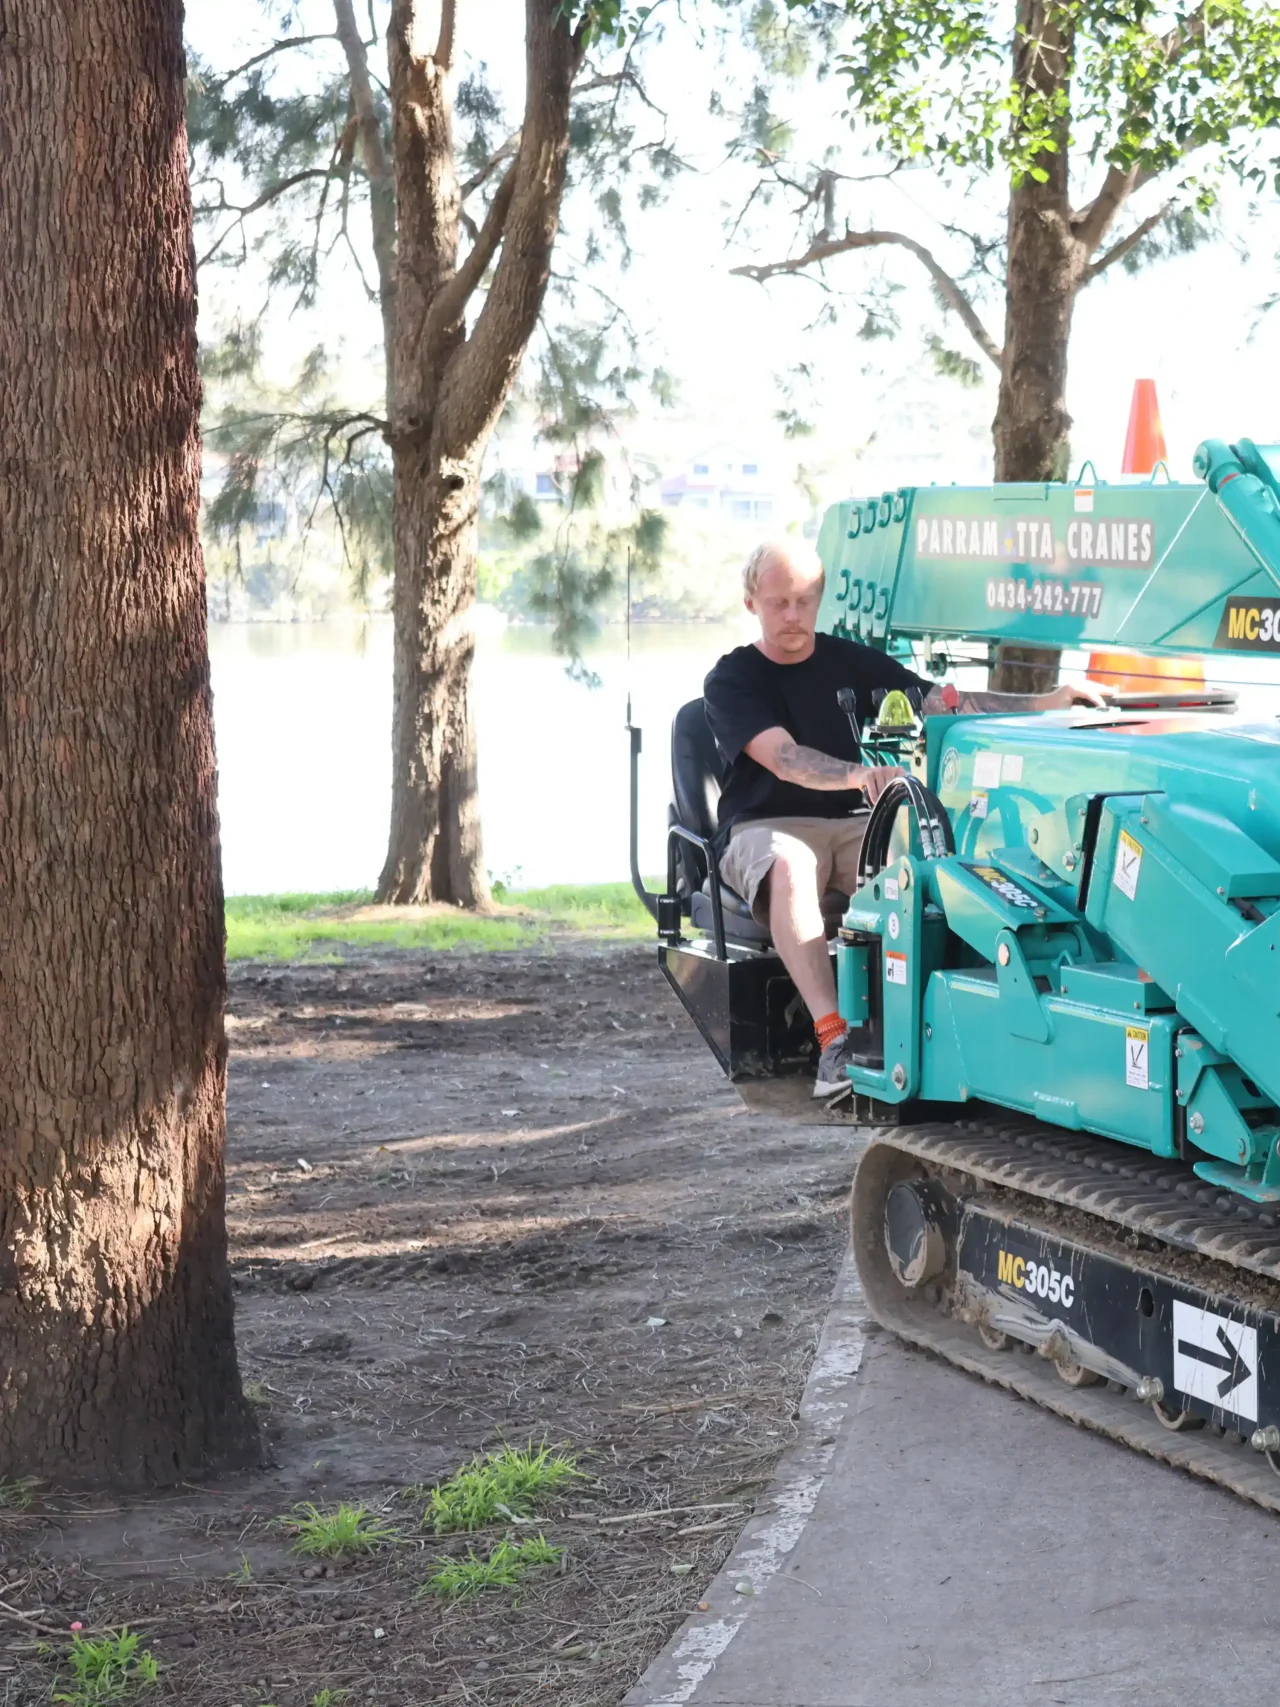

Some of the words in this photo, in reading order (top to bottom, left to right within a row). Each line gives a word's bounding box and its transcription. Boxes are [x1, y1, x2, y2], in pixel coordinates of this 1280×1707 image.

[1067, 520, 1152, 562] CRANES
[987, 582, 1102, 615] 0434-242-777
[972, 867, 1039, 908] MC305C
[997, 1249, 1075, 1309] MC305C
